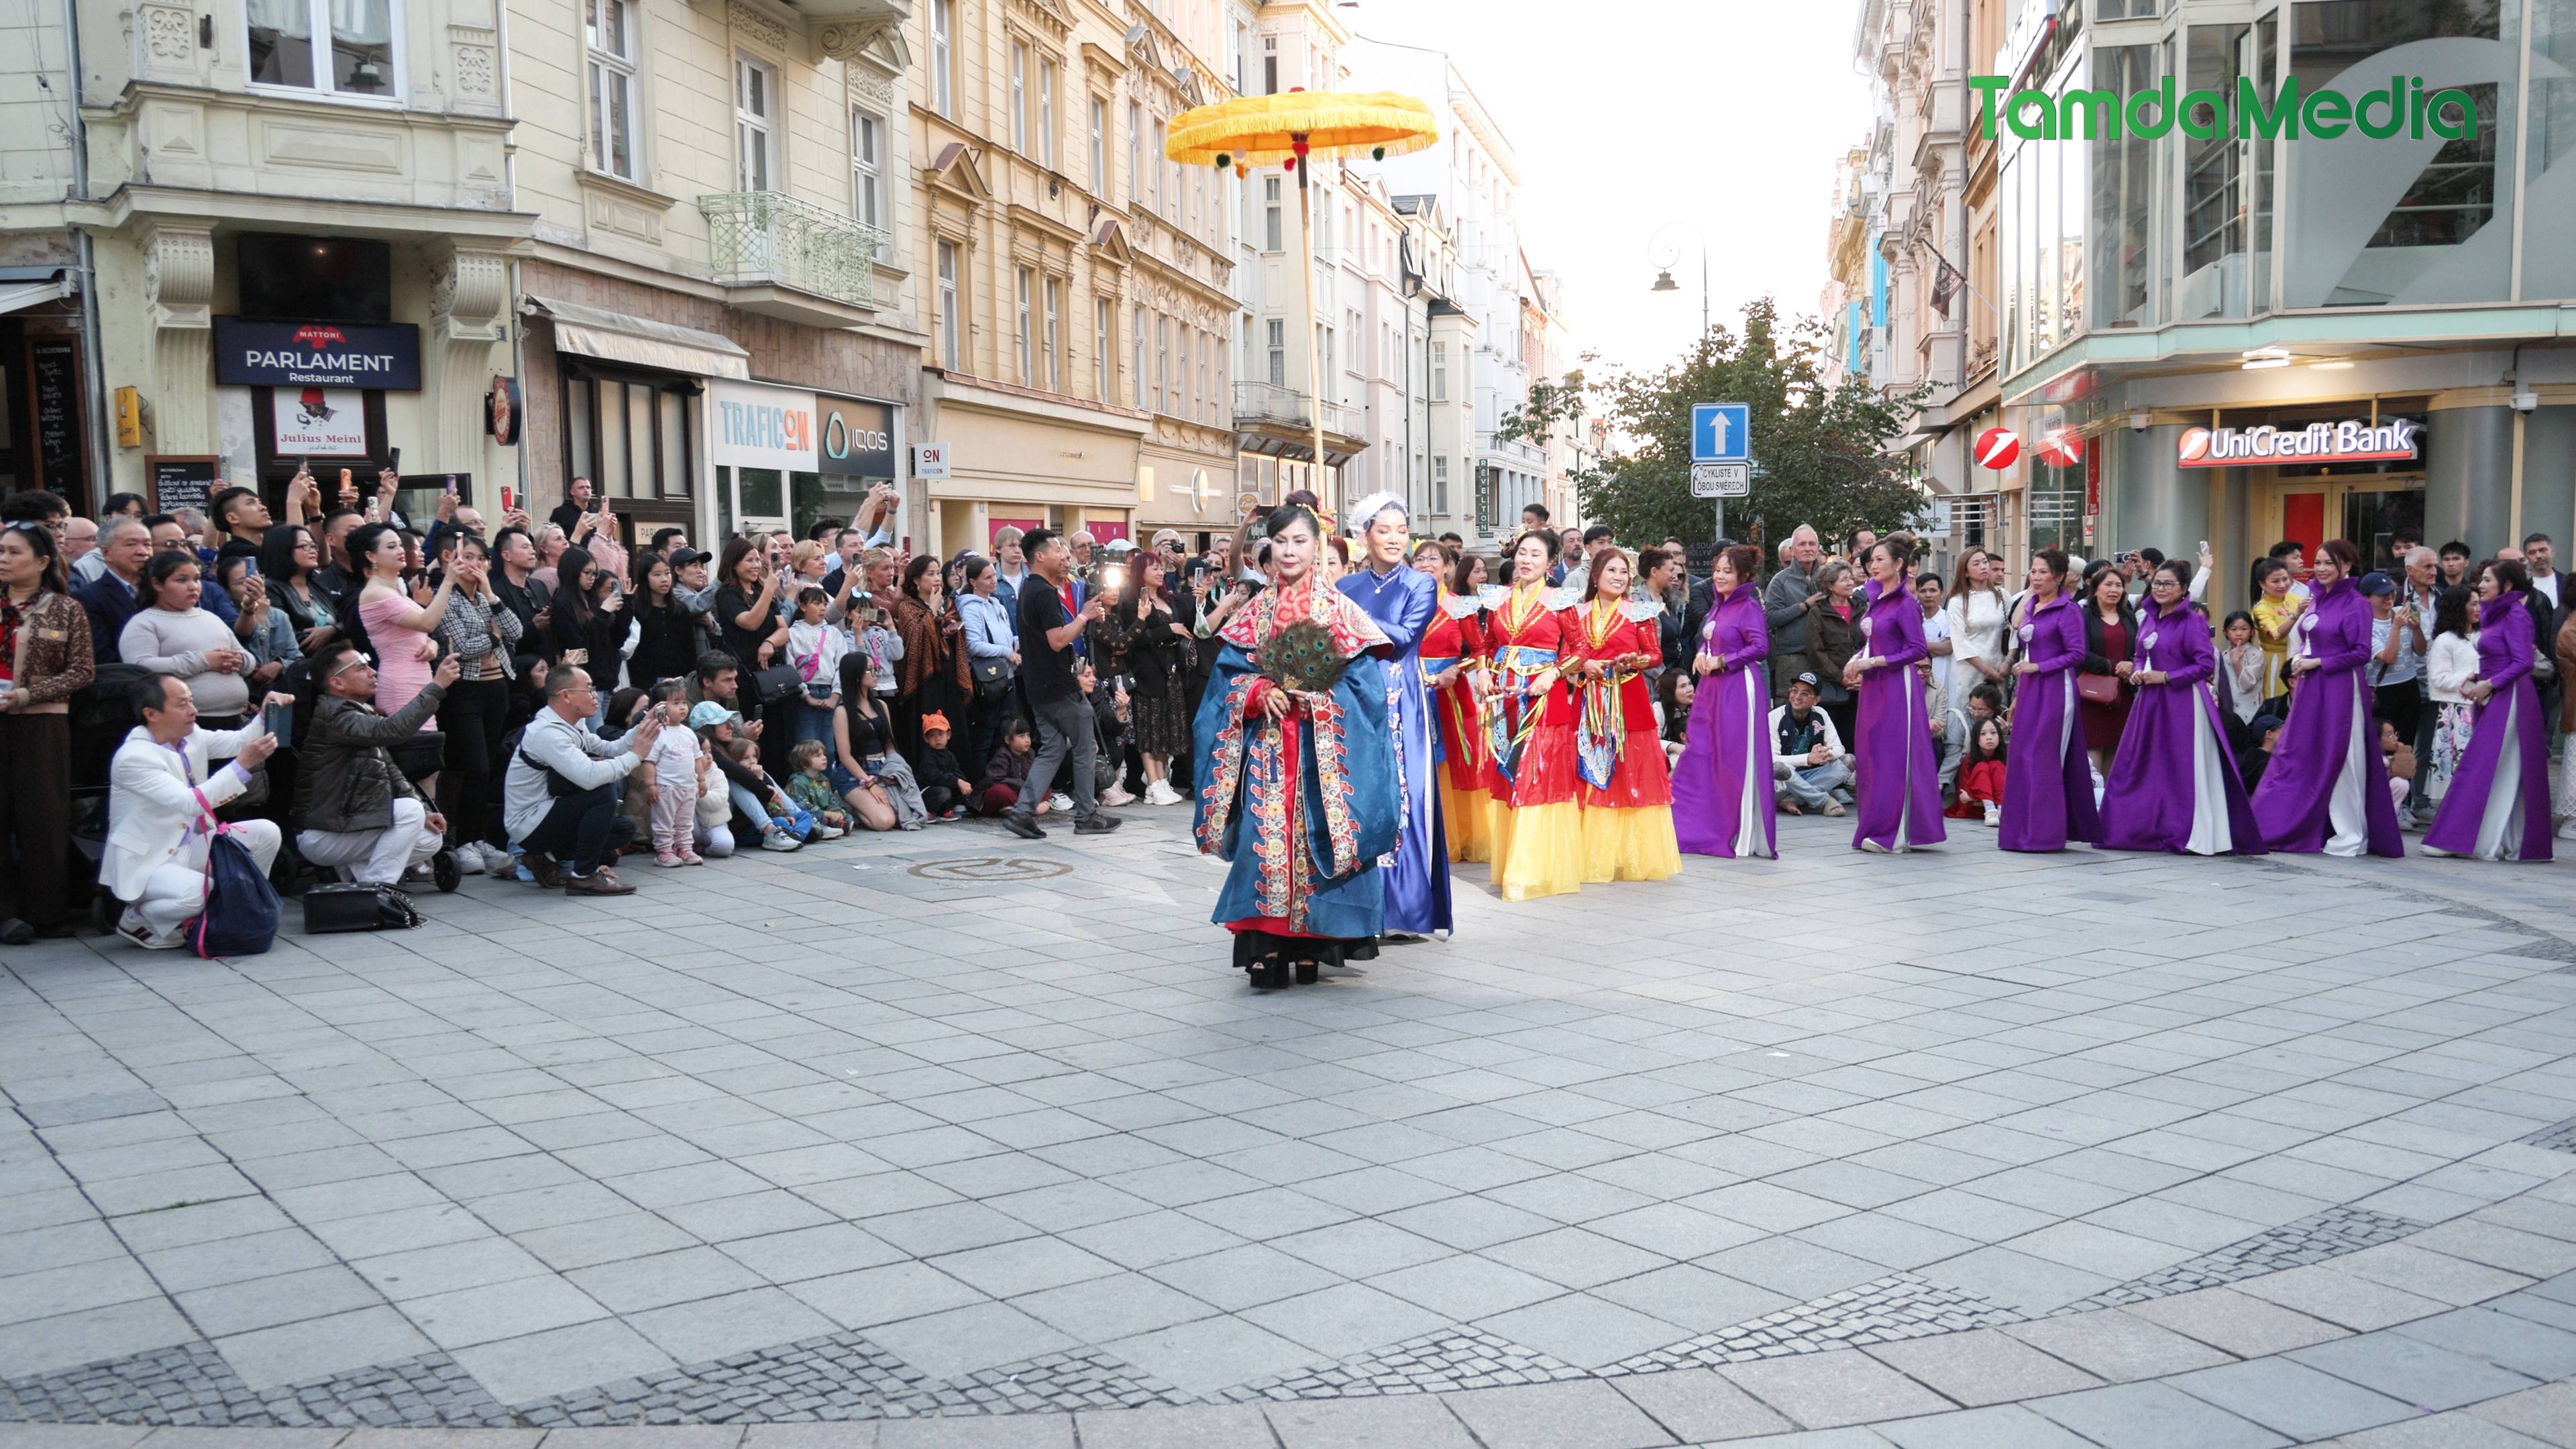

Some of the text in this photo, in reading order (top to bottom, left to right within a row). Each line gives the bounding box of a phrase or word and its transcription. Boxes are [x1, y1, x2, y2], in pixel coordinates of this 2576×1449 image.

[299, 331, 339, 339] MATTONI
[246, 350, 394, 372] PARLAMENT
[289, 372, 354, 383] Restaurant
[720, 400, 809, 451] TRAFICON
[280, 434, 362, 443] Julius Meinl
[851, 428, 888, 451] IQOS
[2211, 421, 2412, 458] UniCredit Bank
[923, 449, 939, 462] ON
[1703, 466, 1739, 478] CYKLISTÉ V
[1697, 482, 1714, 490] OBOU
